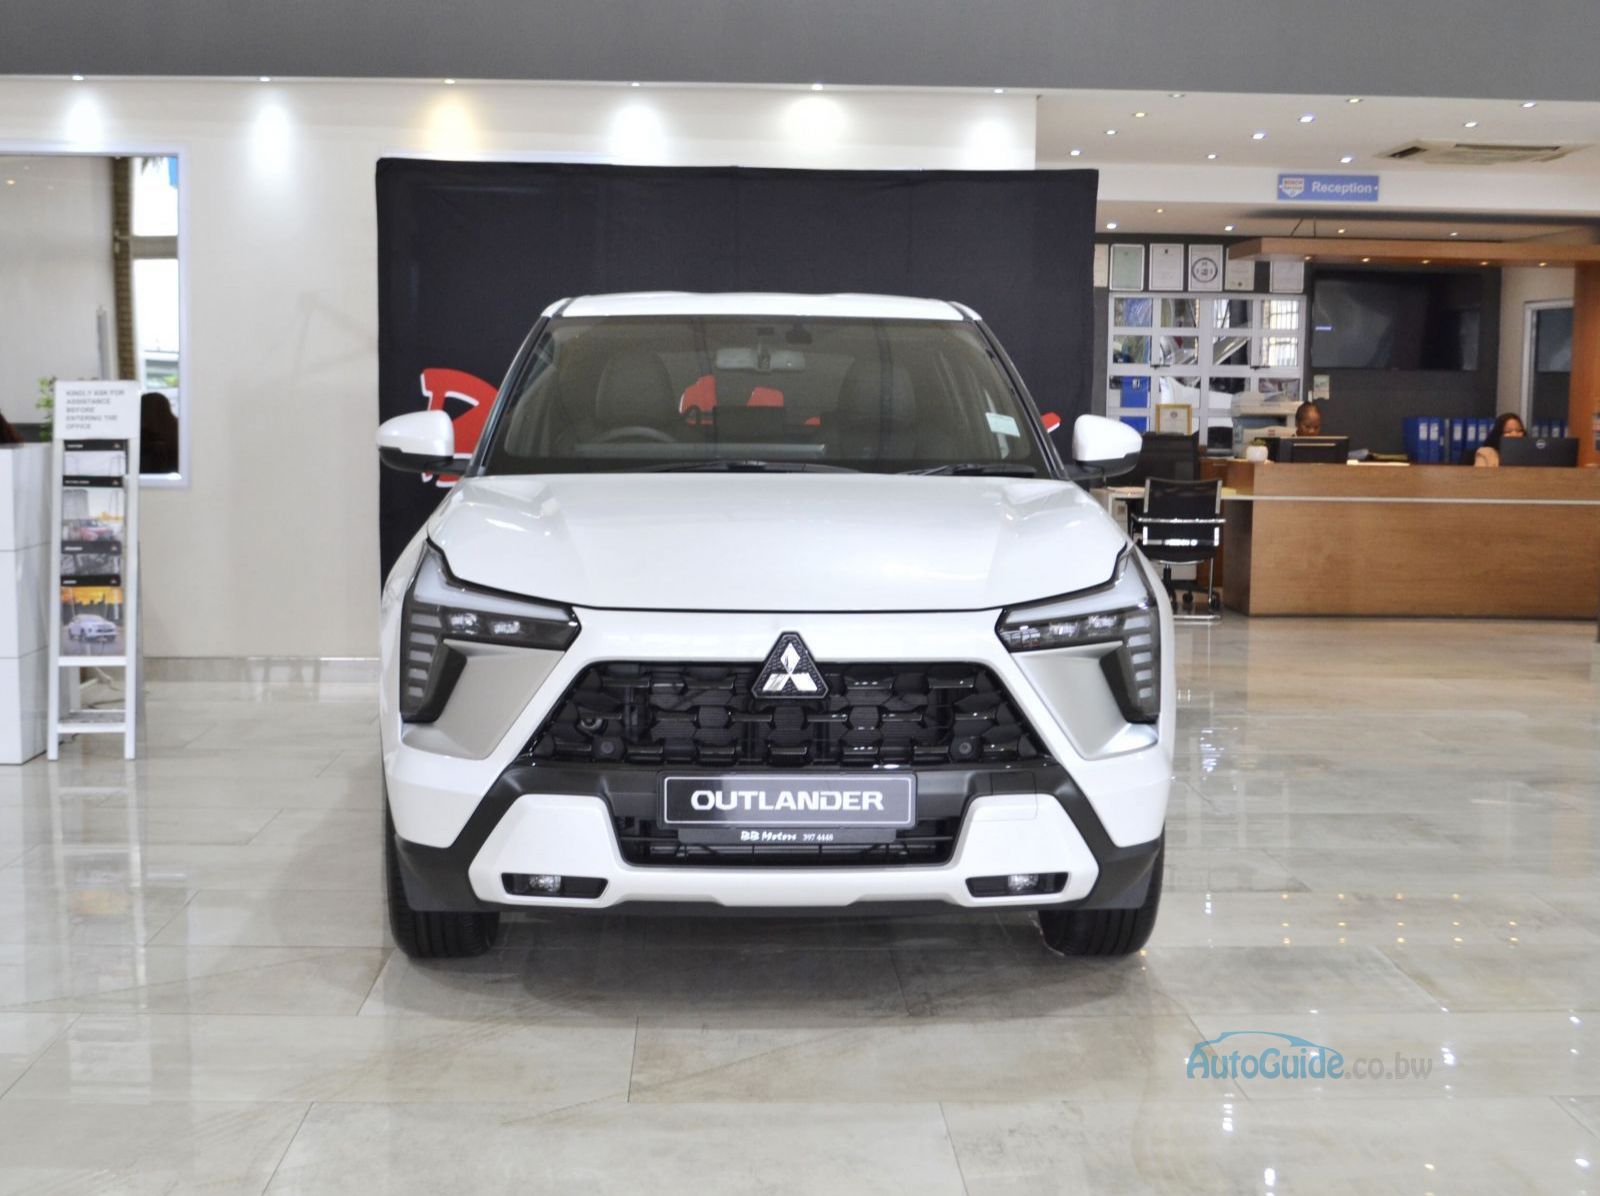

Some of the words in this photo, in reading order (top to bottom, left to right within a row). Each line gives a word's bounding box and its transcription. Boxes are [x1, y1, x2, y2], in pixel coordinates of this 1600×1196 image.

[1312, 181, 1372, 195] Reception
[690, 790, 884, 811] OUTLANDER
[741, 830, 759, 841] BB
[761, 831, 797, 842] Motors
